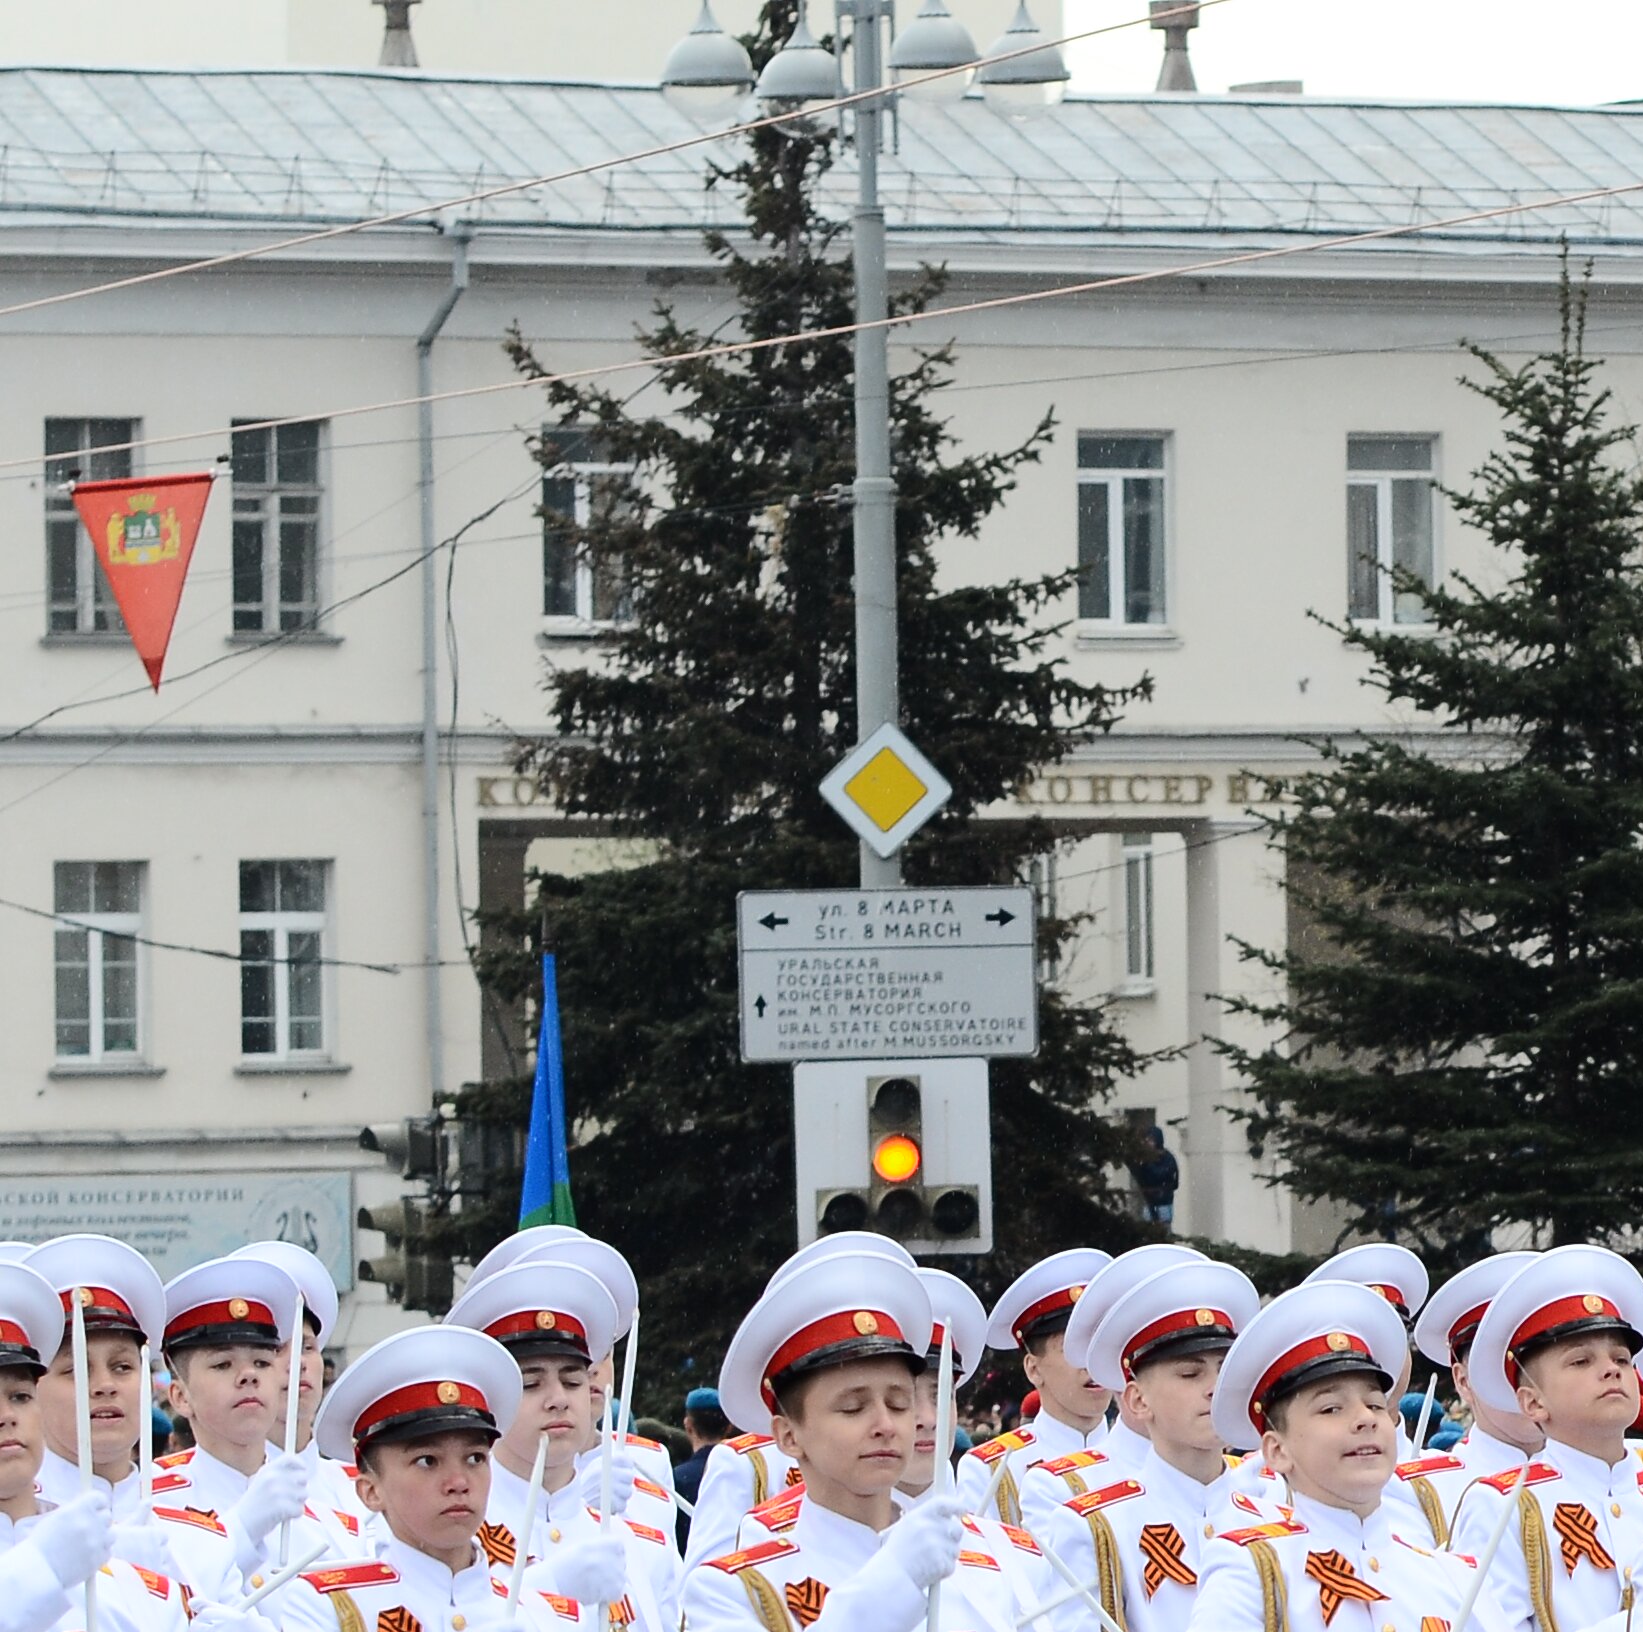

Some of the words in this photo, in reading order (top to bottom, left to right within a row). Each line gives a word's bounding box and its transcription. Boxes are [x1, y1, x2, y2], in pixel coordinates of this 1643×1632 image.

[819, 904, 847, 921] ул.
[858, 900, 869, 916] 8
[880, 898, 955, 917] МАРТА
[815, 924, 853, 941] Str.
[863, 922, 874, 940] 8
[885, 921, 962, 939] MARCH
[777, 957, 880, 972] УРАЛЬСКАЯ
[777, 971, 943, 987] ГОСУДАРСТВЕННАЯ
[777, 987, 923, 1002] КОНСЕРВАТОРИЯ
[850, 1000, 971, 1017] МУСОРГСКОГО
[778, 1021, 822, 1035] URAL
[829, 1019, 881, 1034] STATE
[888, 1016, 1027, 1033] CONSERVATOIRE
[778, 1036, 830, 1051] named
[836, 1035, 876, 1050] after
[68, 1187, 244, 1206] КОНСЕРВАТОРИИ
